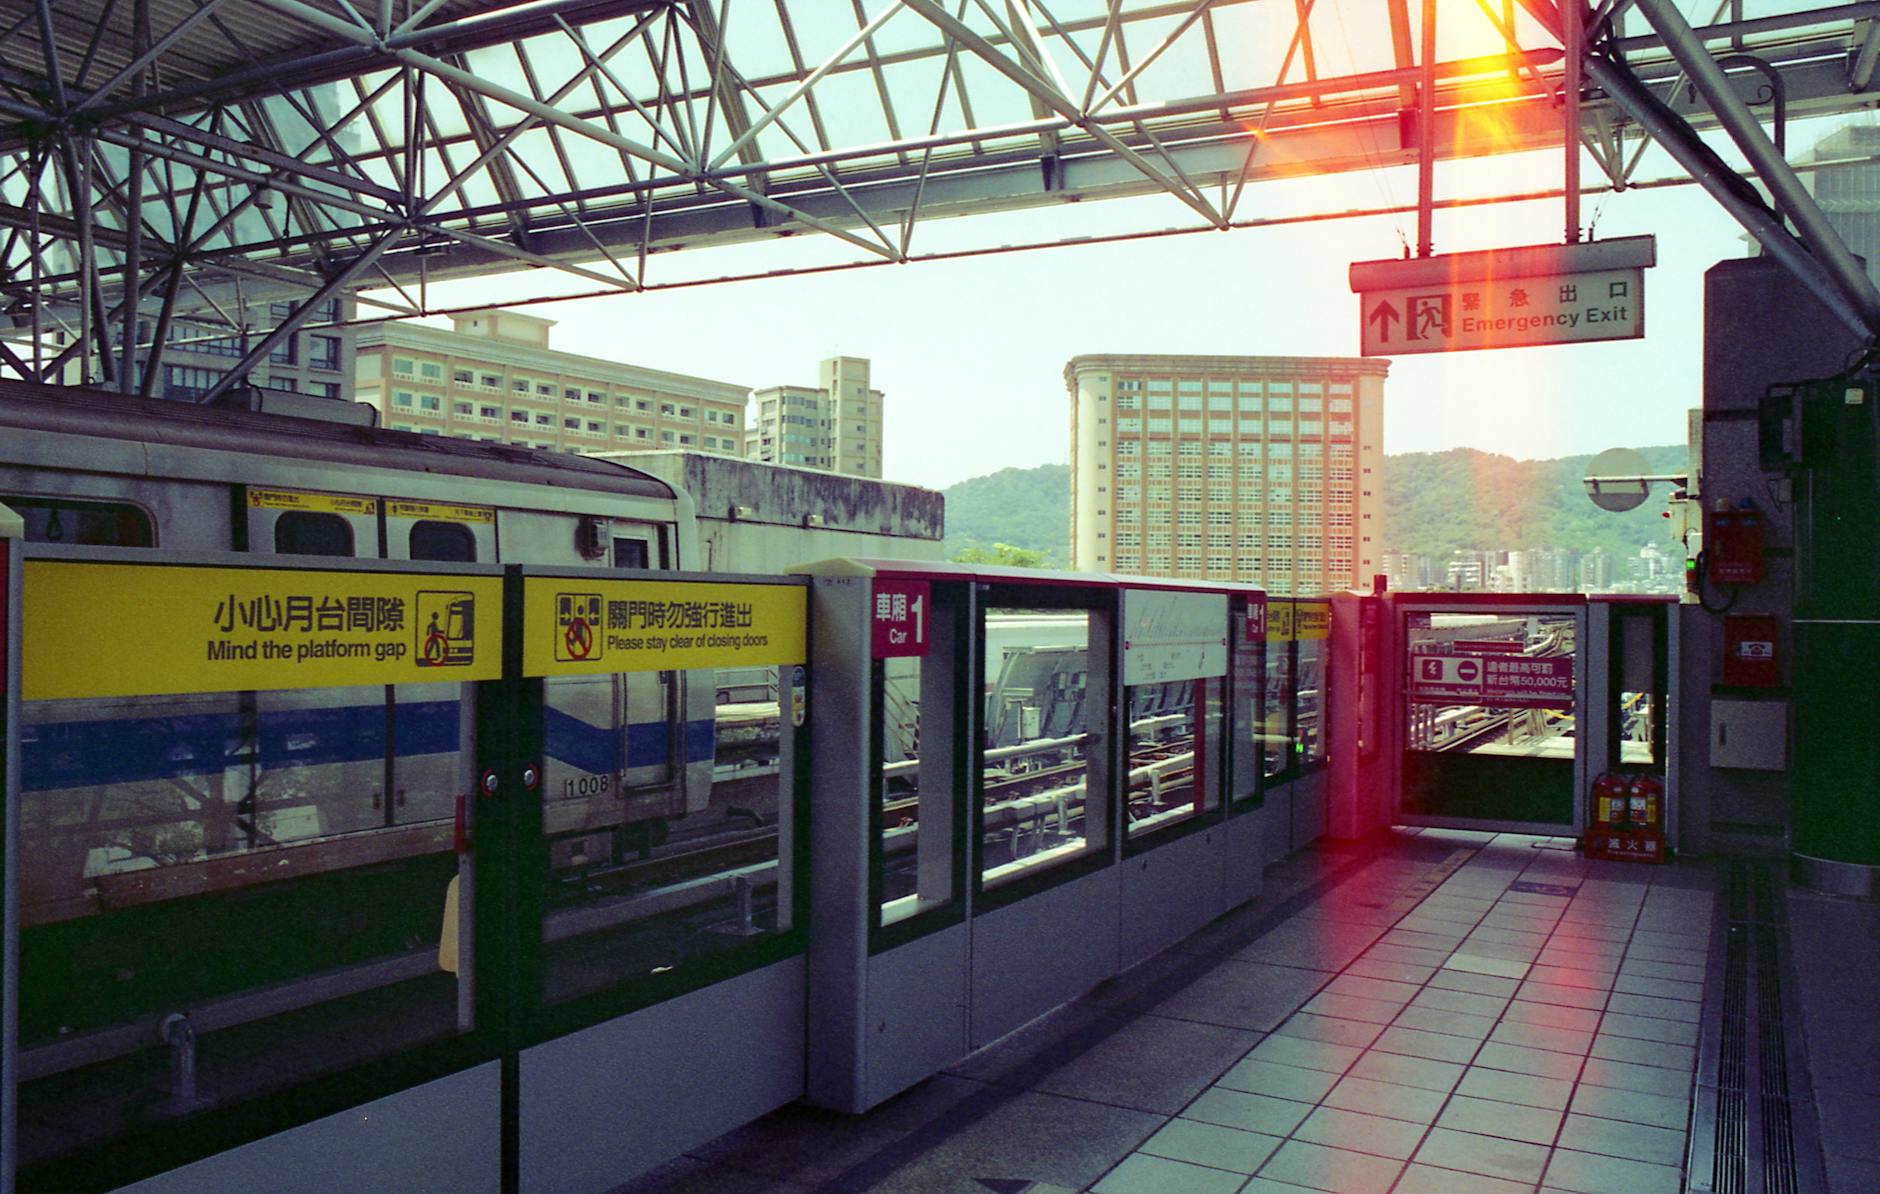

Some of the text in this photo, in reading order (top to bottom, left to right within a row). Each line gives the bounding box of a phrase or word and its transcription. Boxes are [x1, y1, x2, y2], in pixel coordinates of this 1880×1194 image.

[1462, 281, 1628, 311] 緊急出口
[1462, 306, 1628, 333] Emergency Exit
[213, 594, 406, 632] 小心月台間隙
[607, 600, 753, 630] 關門時勿強行進出
[876, 592, 907, 621] 車廂
[911, 594, 923, 643] 1
[608, 633, 768, 652] Please stay clear of closing doors
[889, 628, 907, 644] Car
[207, 639, 406, 663] Mind the platform gap
[567, 775, 609, 796] 1008
